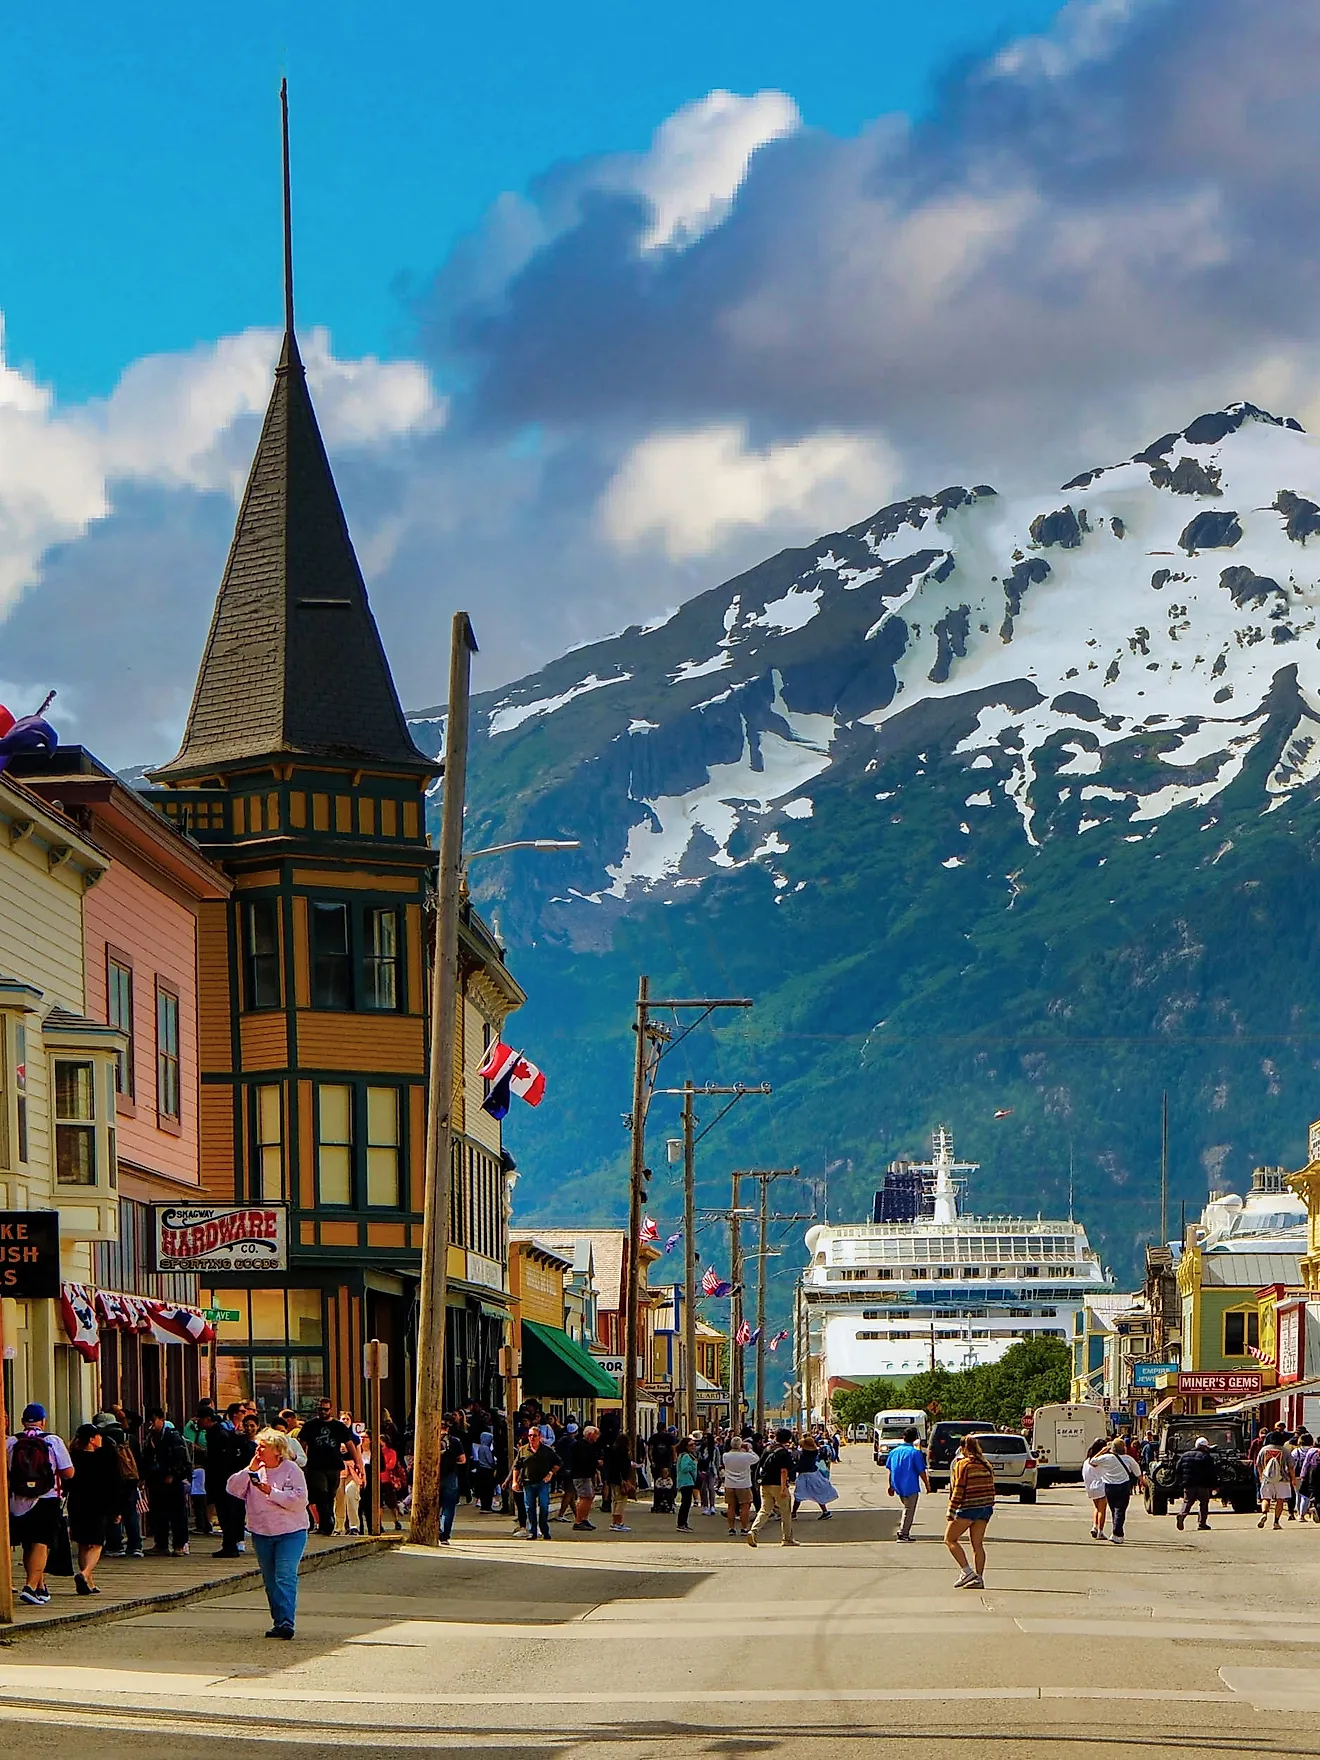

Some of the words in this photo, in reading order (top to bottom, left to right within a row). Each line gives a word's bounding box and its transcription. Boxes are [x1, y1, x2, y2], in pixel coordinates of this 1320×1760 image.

[176, 1210, 214, 1219] SKAGWAY
[0, 1224, 28, 1239] KE
[161, 1211, 277, 1257] HARDWARE
[241, 1244, 258, 1254] CO.
[160, 1259, 231, 1270] SPORTING
[234, 1259, 279, 1270] GOODS
[216, 1312, 230, 1320] AVE
[1181, 1377, 1226, 1388] MINER'S
[1228, 1377, 1259, 1388] GEMS
